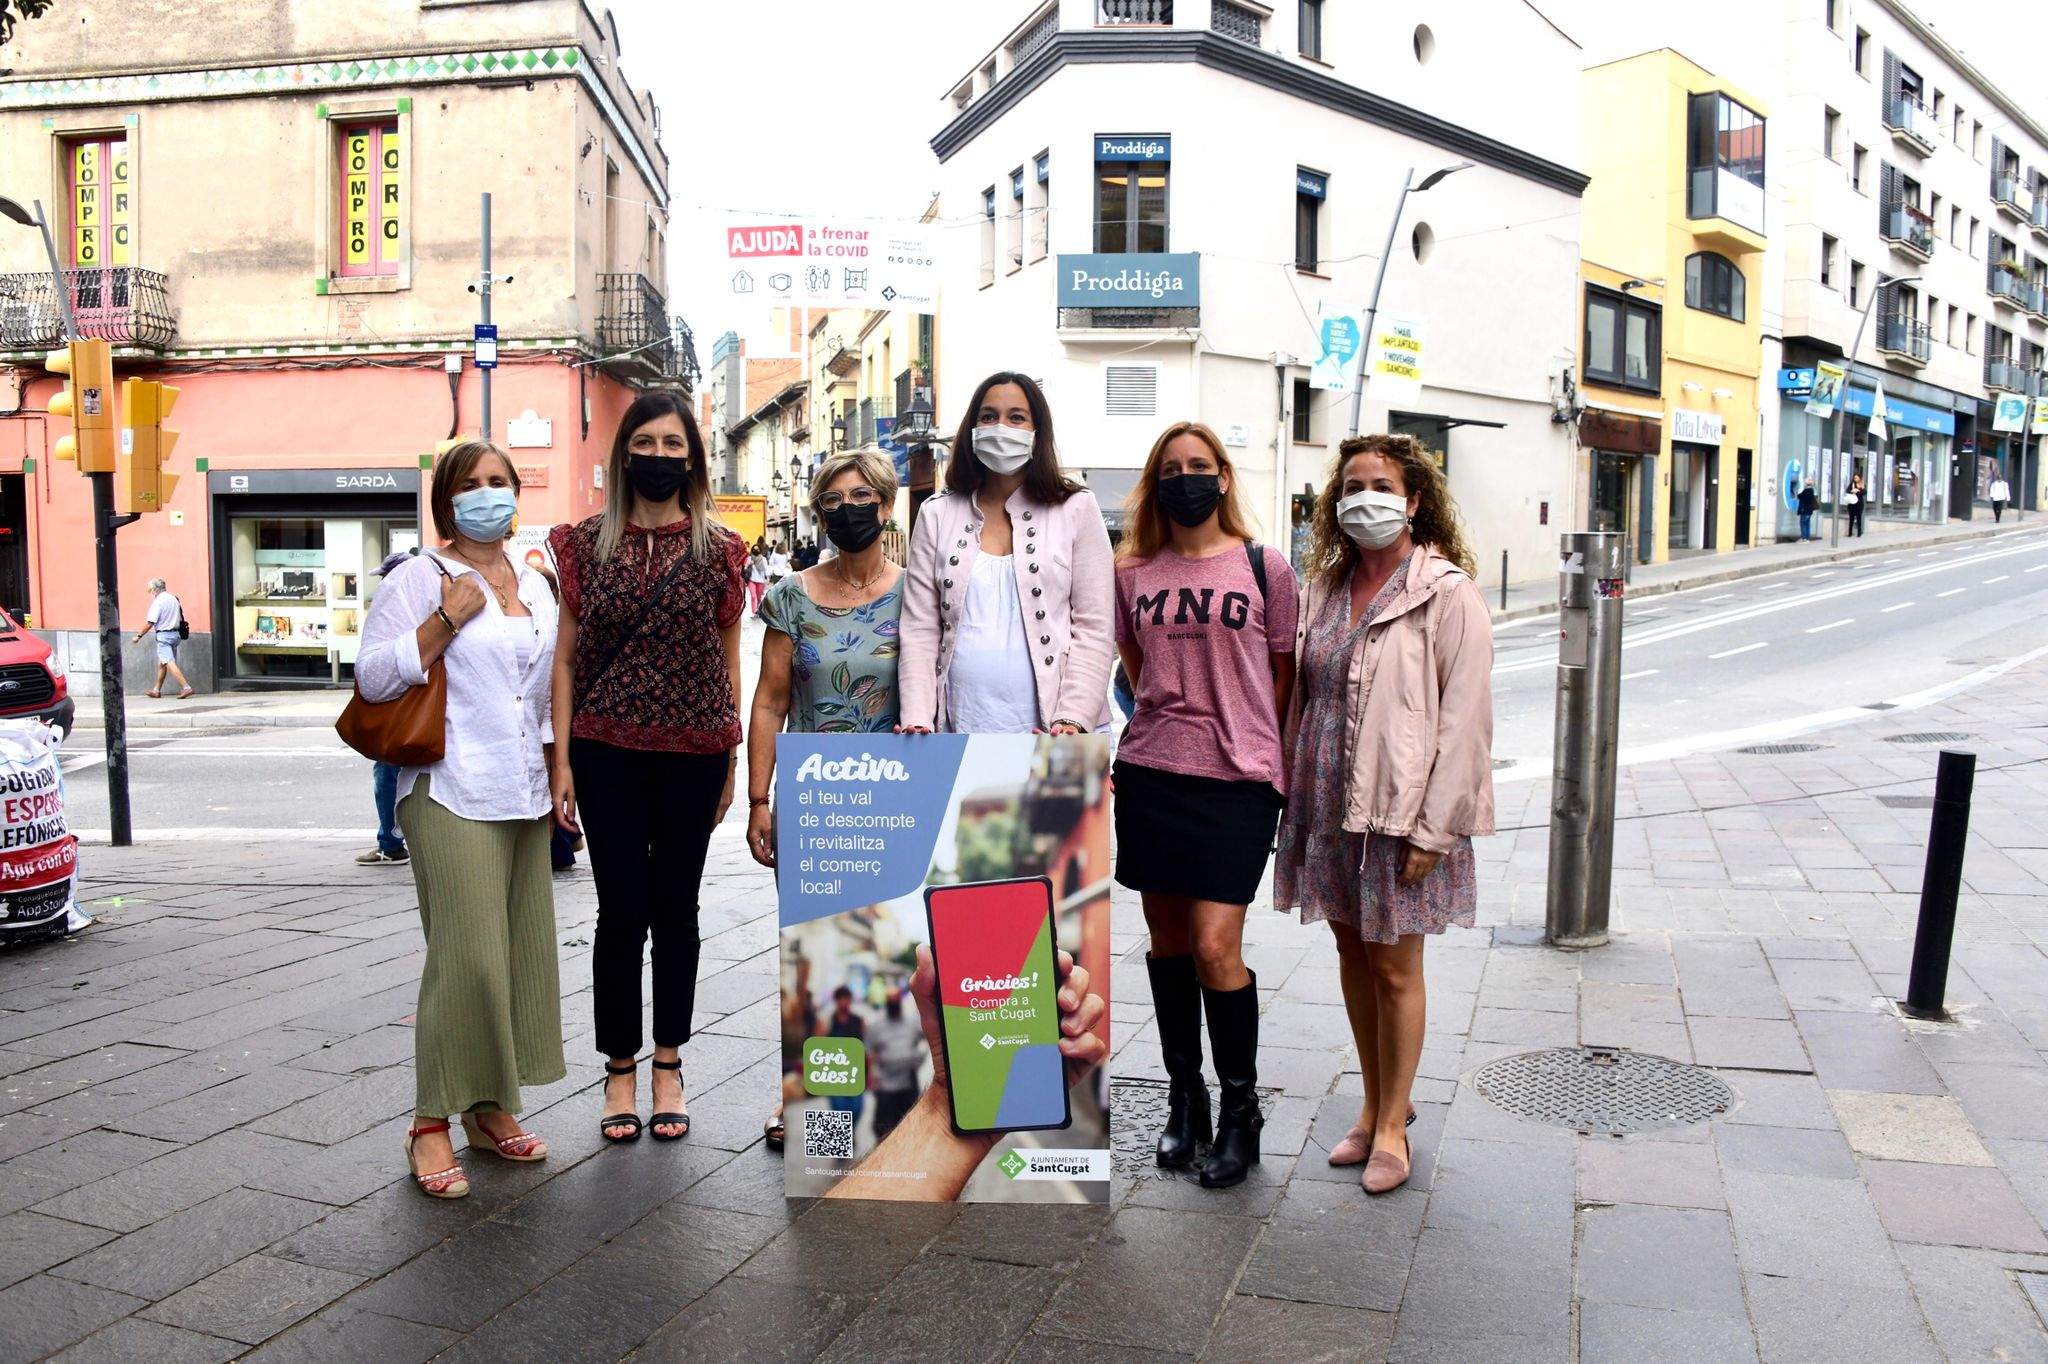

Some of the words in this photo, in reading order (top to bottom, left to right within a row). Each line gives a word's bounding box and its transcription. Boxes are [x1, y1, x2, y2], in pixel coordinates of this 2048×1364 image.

[1102, 142, 1164, 158] Proddigia
[115, 161, 128, 245] ORO
[351, 138, 366, 253] COMPRO
[384, 149, 398, 240] ORO
[81, 151, 94, 260] COMPRO
[731, 229, 800, 253] AJUDA
[809, 230, 816, 239] a
[822, 227, 869, 241] frenar
[808, 244, 821, 256] la
[826, 245, 869, 257] COVID
[1072, 270, 1184, 298] Proddigia
[1675, 411, 1693, 437] Rita
[336, 473, 397, 487] SARDÀ
[1135, 588, 1250, 631] MNG
[796, 752, 910, 782] Activa
[799, 789, 812, 804] el
[818, 790, 843, 804] teu
[850, 790, 872, 804] val
[799, 812, 819, 827] de
[825, 812, 916, 831] descompte
[800, 834, 803, 849] i
[809, 834, 885, 850] revitalitza
[2, 861, 35, 881] App
[800, 857, 813, 871] el
[819, 859, 882, 876] comerç
[800, 878, 842, 894] local!
[17, 904, 42, 917] App
[960, 972, 1038, 993] Gràcies!
[970, 997, 1018, 1009] Compra
[1022, 996, 1029, 1005] a
[969, 1010, 996, 1022] Sant
[1000, 1007, 1036, 1021] Cugat
[1030, 1163, 1090, 1175] SantCugat
